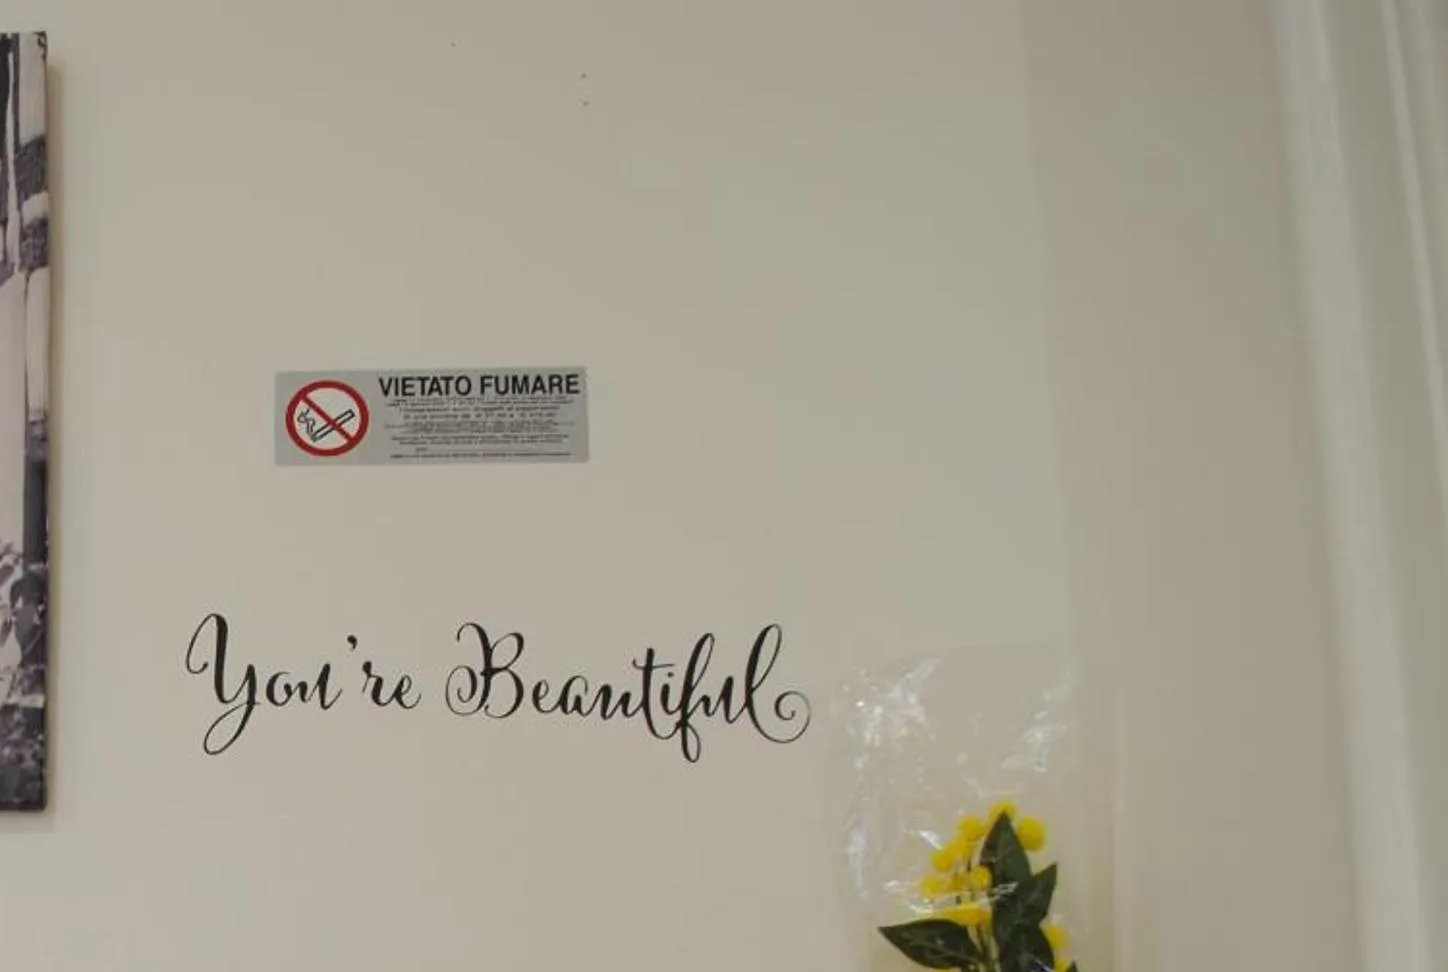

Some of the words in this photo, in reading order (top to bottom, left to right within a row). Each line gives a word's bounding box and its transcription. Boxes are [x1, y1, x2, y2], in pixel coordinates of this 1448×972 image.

[378, 375, 472, 397] VIETATO
[479, 373, 581, 396] FUMARE
[184, 612, 423, 757] You're
[444, 622, 812, 764] Beautiful
